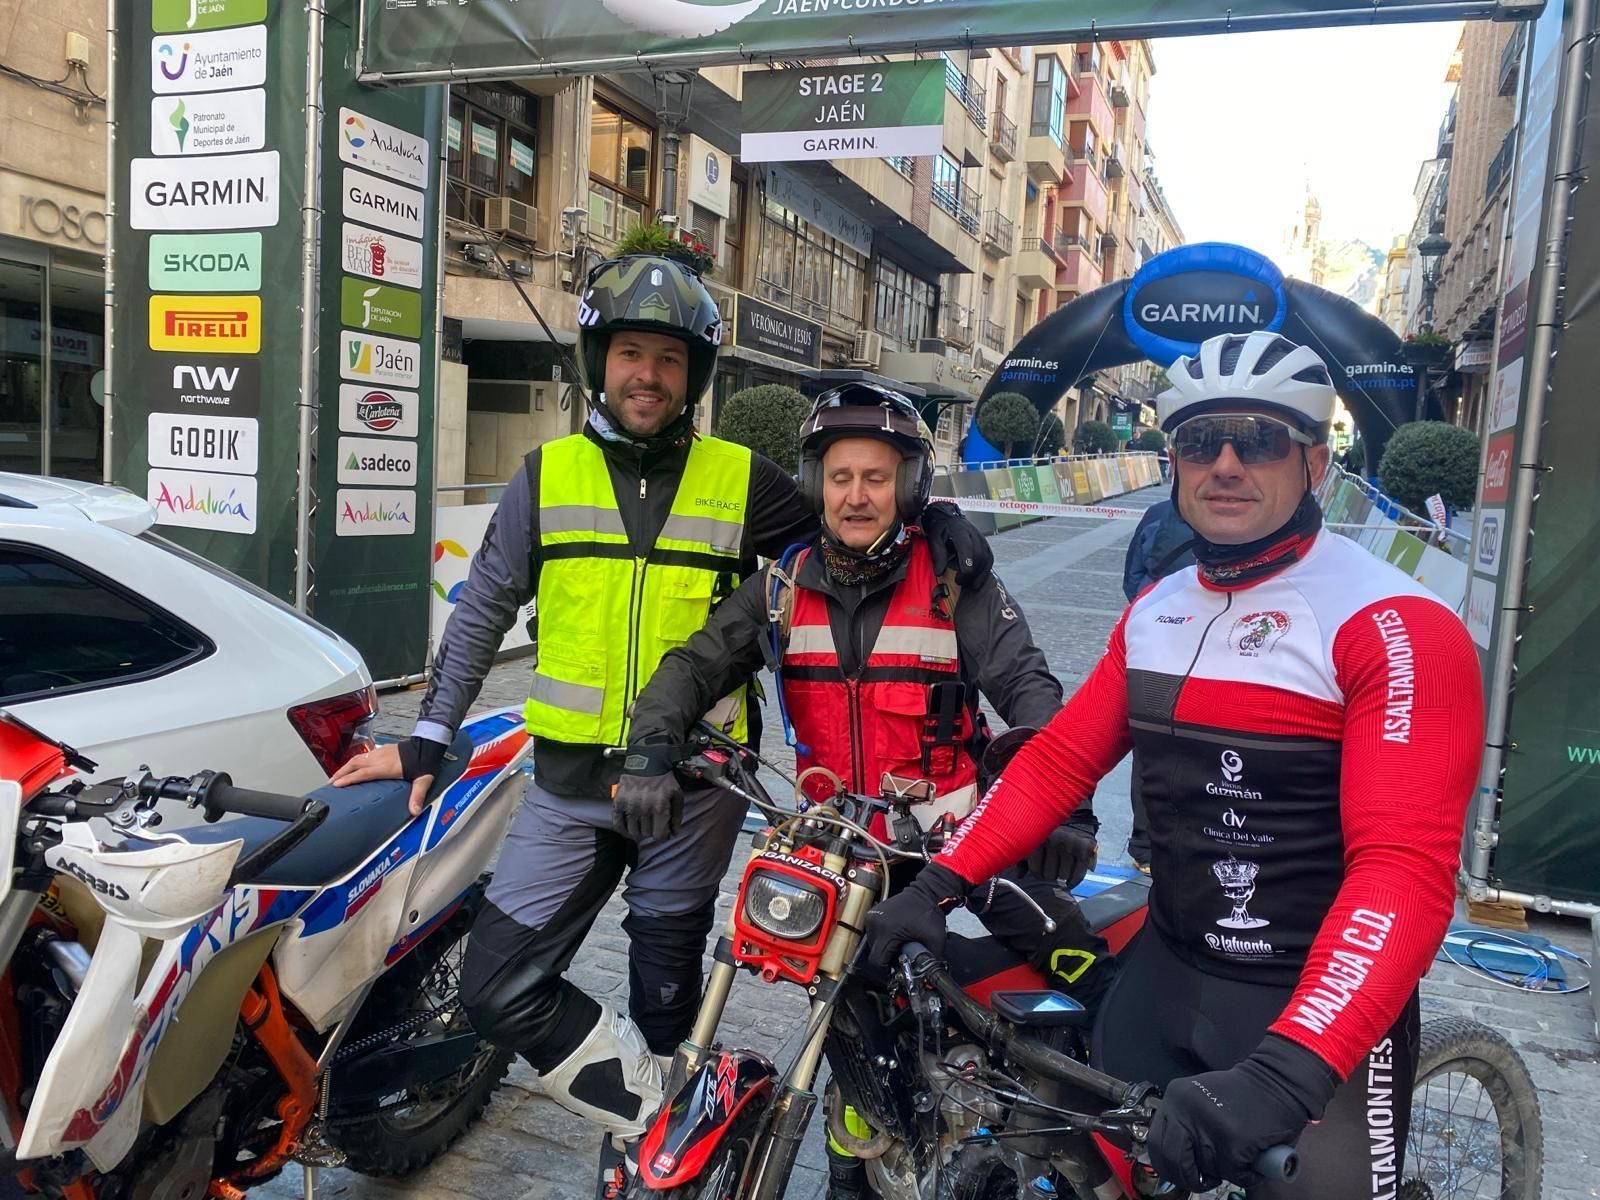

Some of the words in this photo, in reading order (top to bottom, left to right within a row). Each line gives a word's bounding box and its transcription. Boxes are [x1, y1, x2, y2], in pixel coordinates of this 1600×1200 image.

[194, 48, 262, 66] Ayuntamiento
[194, 69, 207, 79] de
[209, 65, 233, 78] Jaén
[799, 74, 865, 96] STAGE
[871, 73, 883, 92] 2
[193, 112, 225, 122] Patronato
[815, 100, 865, 123] JAÉN
[193, 124, 225, 135] Municipal
[227, 124, 235, 132] de
[193, 138, 223, 148] Deportes
[225, 137, 234, 145] de
[235, 135, 250, 144] Jaén
[370, 129, 424, 166] Andalucía
[803, 136, 875, 152] GARMIN
[145, 177, 264, 206] GARMIN
[349, 187, 418, 222] GARMIN
[1141, 303, 1261, 323] GARMIN
[165, 311, 248, 337] PIRELLI
[750, 312, 788, 338] VERÓNICA
[794, 327, 812, 346] JESÚS
[375, 344, 413, 372] Jaén
[1004, 357, 1059, 370] garmin.es
[1001, 370, 1056, 384] garmin.pt
[1345, 361, 1414, 377] garmin.es
[1347, 376, 1416, 391] garmin.pt
[180, 395, 230, 405] northwave
[365, 404, 400, 420] Carloteña
[171, 426, 239, 460] GOBIK
[361, 453, 411, 472] sadeco
[155, 481, 250, 521] Andalucía
[695, 498, 715, 507] BIKE
[716, 501, 741, 511] RACE
[1000, 501, 1038, 513] octagon
[341, 501, 411, 524] Andalucía
[1086, 507, 1127, 518] octagon
[1155, 615, 1186, 625] FLOWER
[1372, 608, 1415, 744] ASALTAMONTES
[1206, 783, 1262, 800] Guzmán
[941, 778, 1003, 857] ASALTAMONTES
[1233, 832, 1249, 841] Del
[1251, 833, 1275, 843] Valle
[348, 857, 391, 903] SLOVAKIA
[987, 877, 998, 904] GARMIN
[1342, 908, 1396, 952] C.D.
[1367, 1037, 1397, 1200] LTAMONTES
